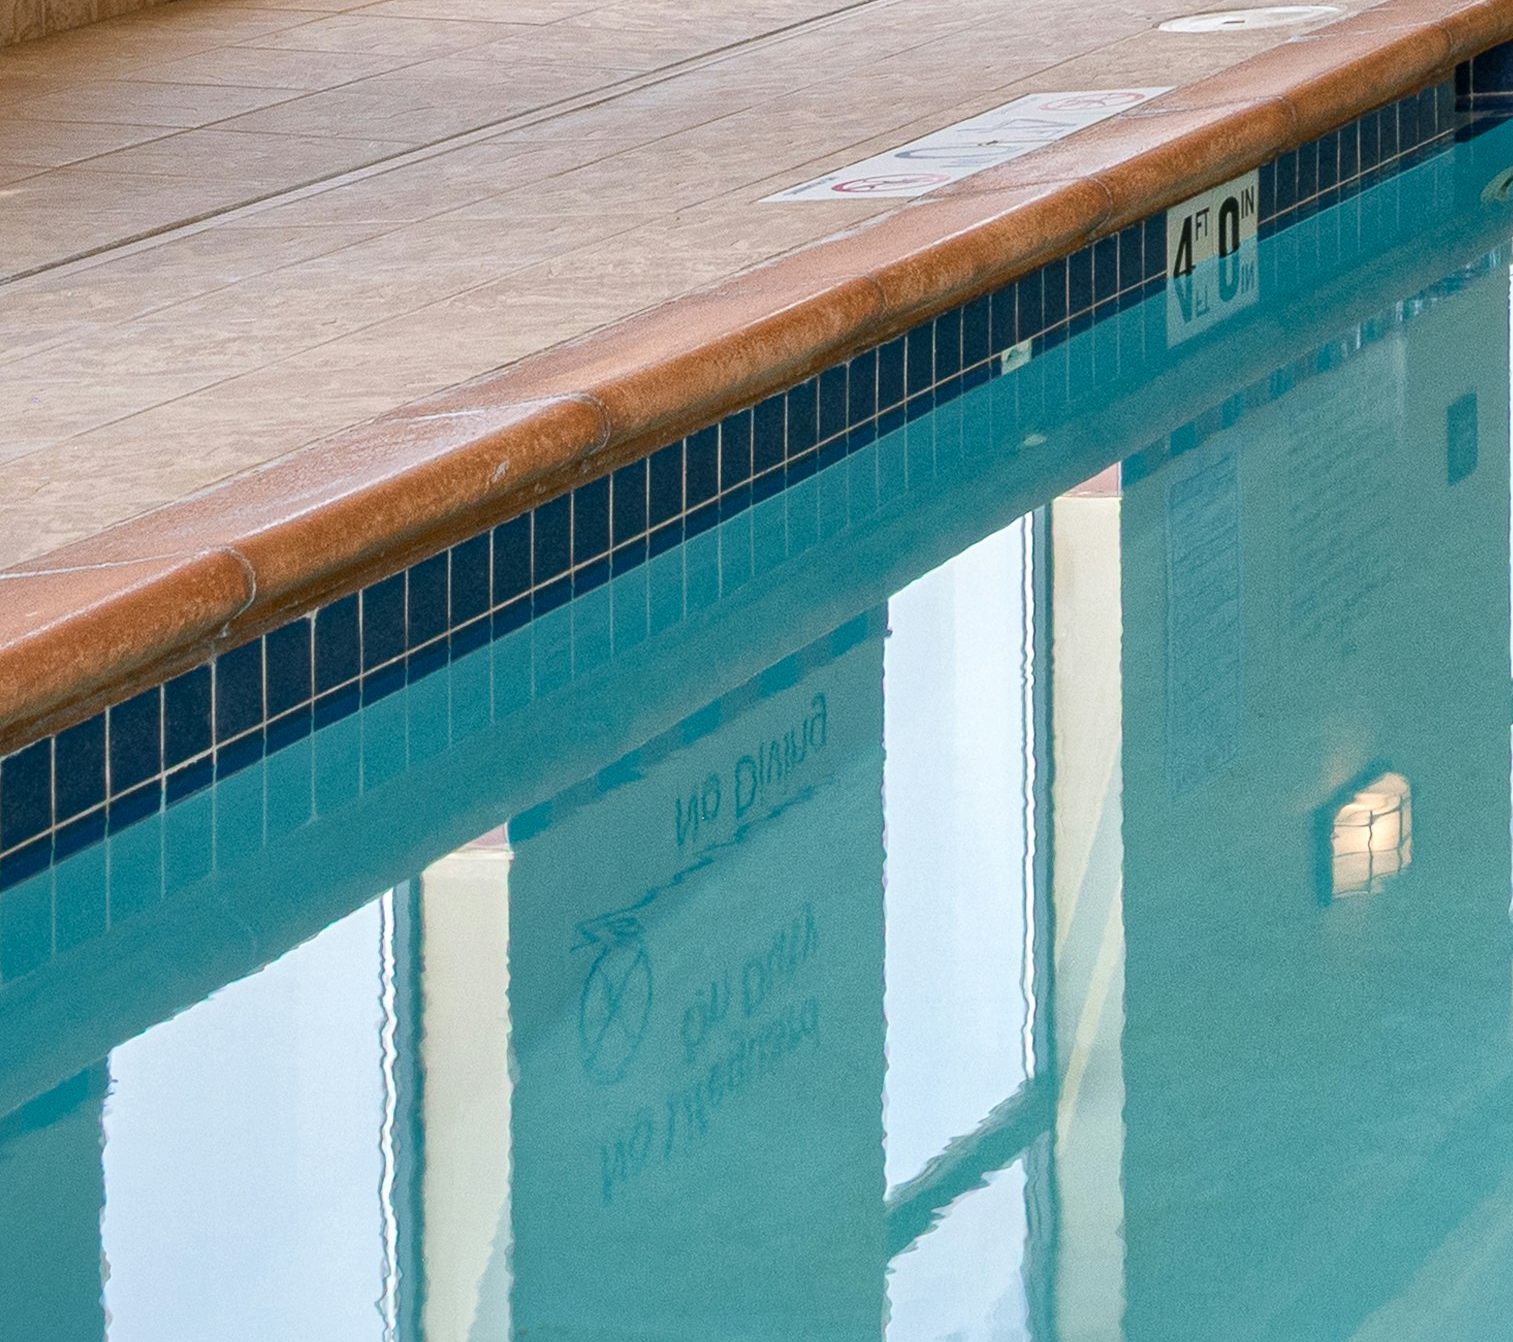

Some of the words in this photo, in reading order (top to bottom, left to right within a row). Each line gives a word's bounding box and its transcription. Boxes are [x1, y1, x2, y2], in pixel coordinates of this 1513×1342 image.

[1173, 214, 1196, 279] 4
[1196, 207, 1210, 241] FT
[1241, 186, 1254, 219] IN
